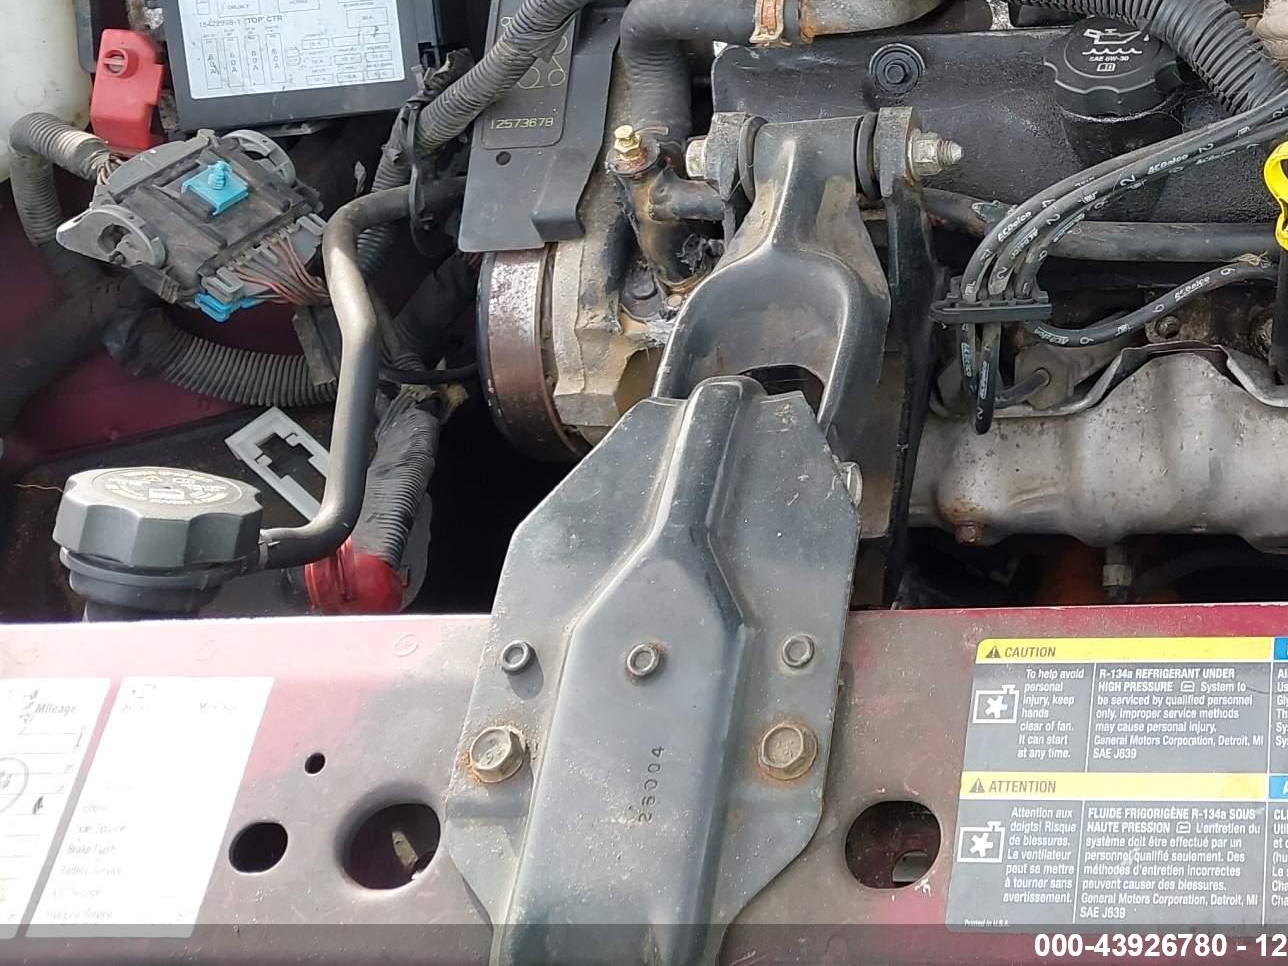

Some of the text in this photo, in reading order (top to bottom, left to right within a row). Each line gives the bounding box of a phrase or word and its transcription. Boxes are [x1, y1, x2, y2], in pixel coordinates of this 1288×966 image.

[490, 118, 553, 130] 12573678
[998, 211, 1032, 242] ACDelco
[1004, 647, 1056, 658] CAUTION
[1026, 669, 1084, 680] To help avoid
[1100, 669, 1235, 679] R-134a REFRIGERANT UNDER
[1024, 682, 1063, 693] personal
[1098, 682, 1246, 693] HIGH PRESSURE System to
[1023, 695, 1074, 706] injury, keep
[1098, 695, 1252, 707] be serviced by qualified personnel
[35, 703, 77, 714] Mileage
[1022, 708, 1049, 718] hands
[1096, 708, 1239, 720] only. Improper service methods
[1020, 721, 1074, 731] clear of fan.
[1096, 721, 1217, 733] may cause personal injury.
[1019, 735, 1068, 745] It can start
[1094, 735, 1263, 747] General Motors Corporation, Detroit, MI
[1017, 748, 1071, 760] at any time.
[1093, 748, 1111, 758] SAE
[989, 781, 1056, 793] ATTENTION
[1011, 808, 1073, 818] Attention aux
[1088, 808, 1122, 818] FLUIDE
[1191, 809, 1226, 819] R-134a
[1229, 809, 1256, 820] SOUS
[1044, 822, 1076, 833] Risque
[1087, 822, 1260, 834] HAUTE PRESSION L'entretien du
[1009, 836, 1071, 846] de blessures.
[1128, 836, 1146, 847] doit
[1211, 838, 1228, 849] par
[1230, 839, 1242, 848] un
[1007, 850, 1071, 860] Le ventilateur
[1171, 851, 1223, 862] seulement.
[1227, 852, 1245, 862] Des
[1005, 864, 1074, 875] peut se mettre
[1133, 865, 1185, 876] d'entretien
[1187, 865, 1241, 877] incorrectes
[1272, 867, 1284, 877] Le
[1013, 879, 1047, 888] tourner
[1050, 879, 1073, 888] sans
[1082, 879, 1226, 890] peuvent causer des blessures.
[1003, 892, 1072, 903] avertissement.
[1081, 893, 1258, 907] General Motors Corporation, Detroit, MI
[1080, 907, 1125, 919] SAE J639
